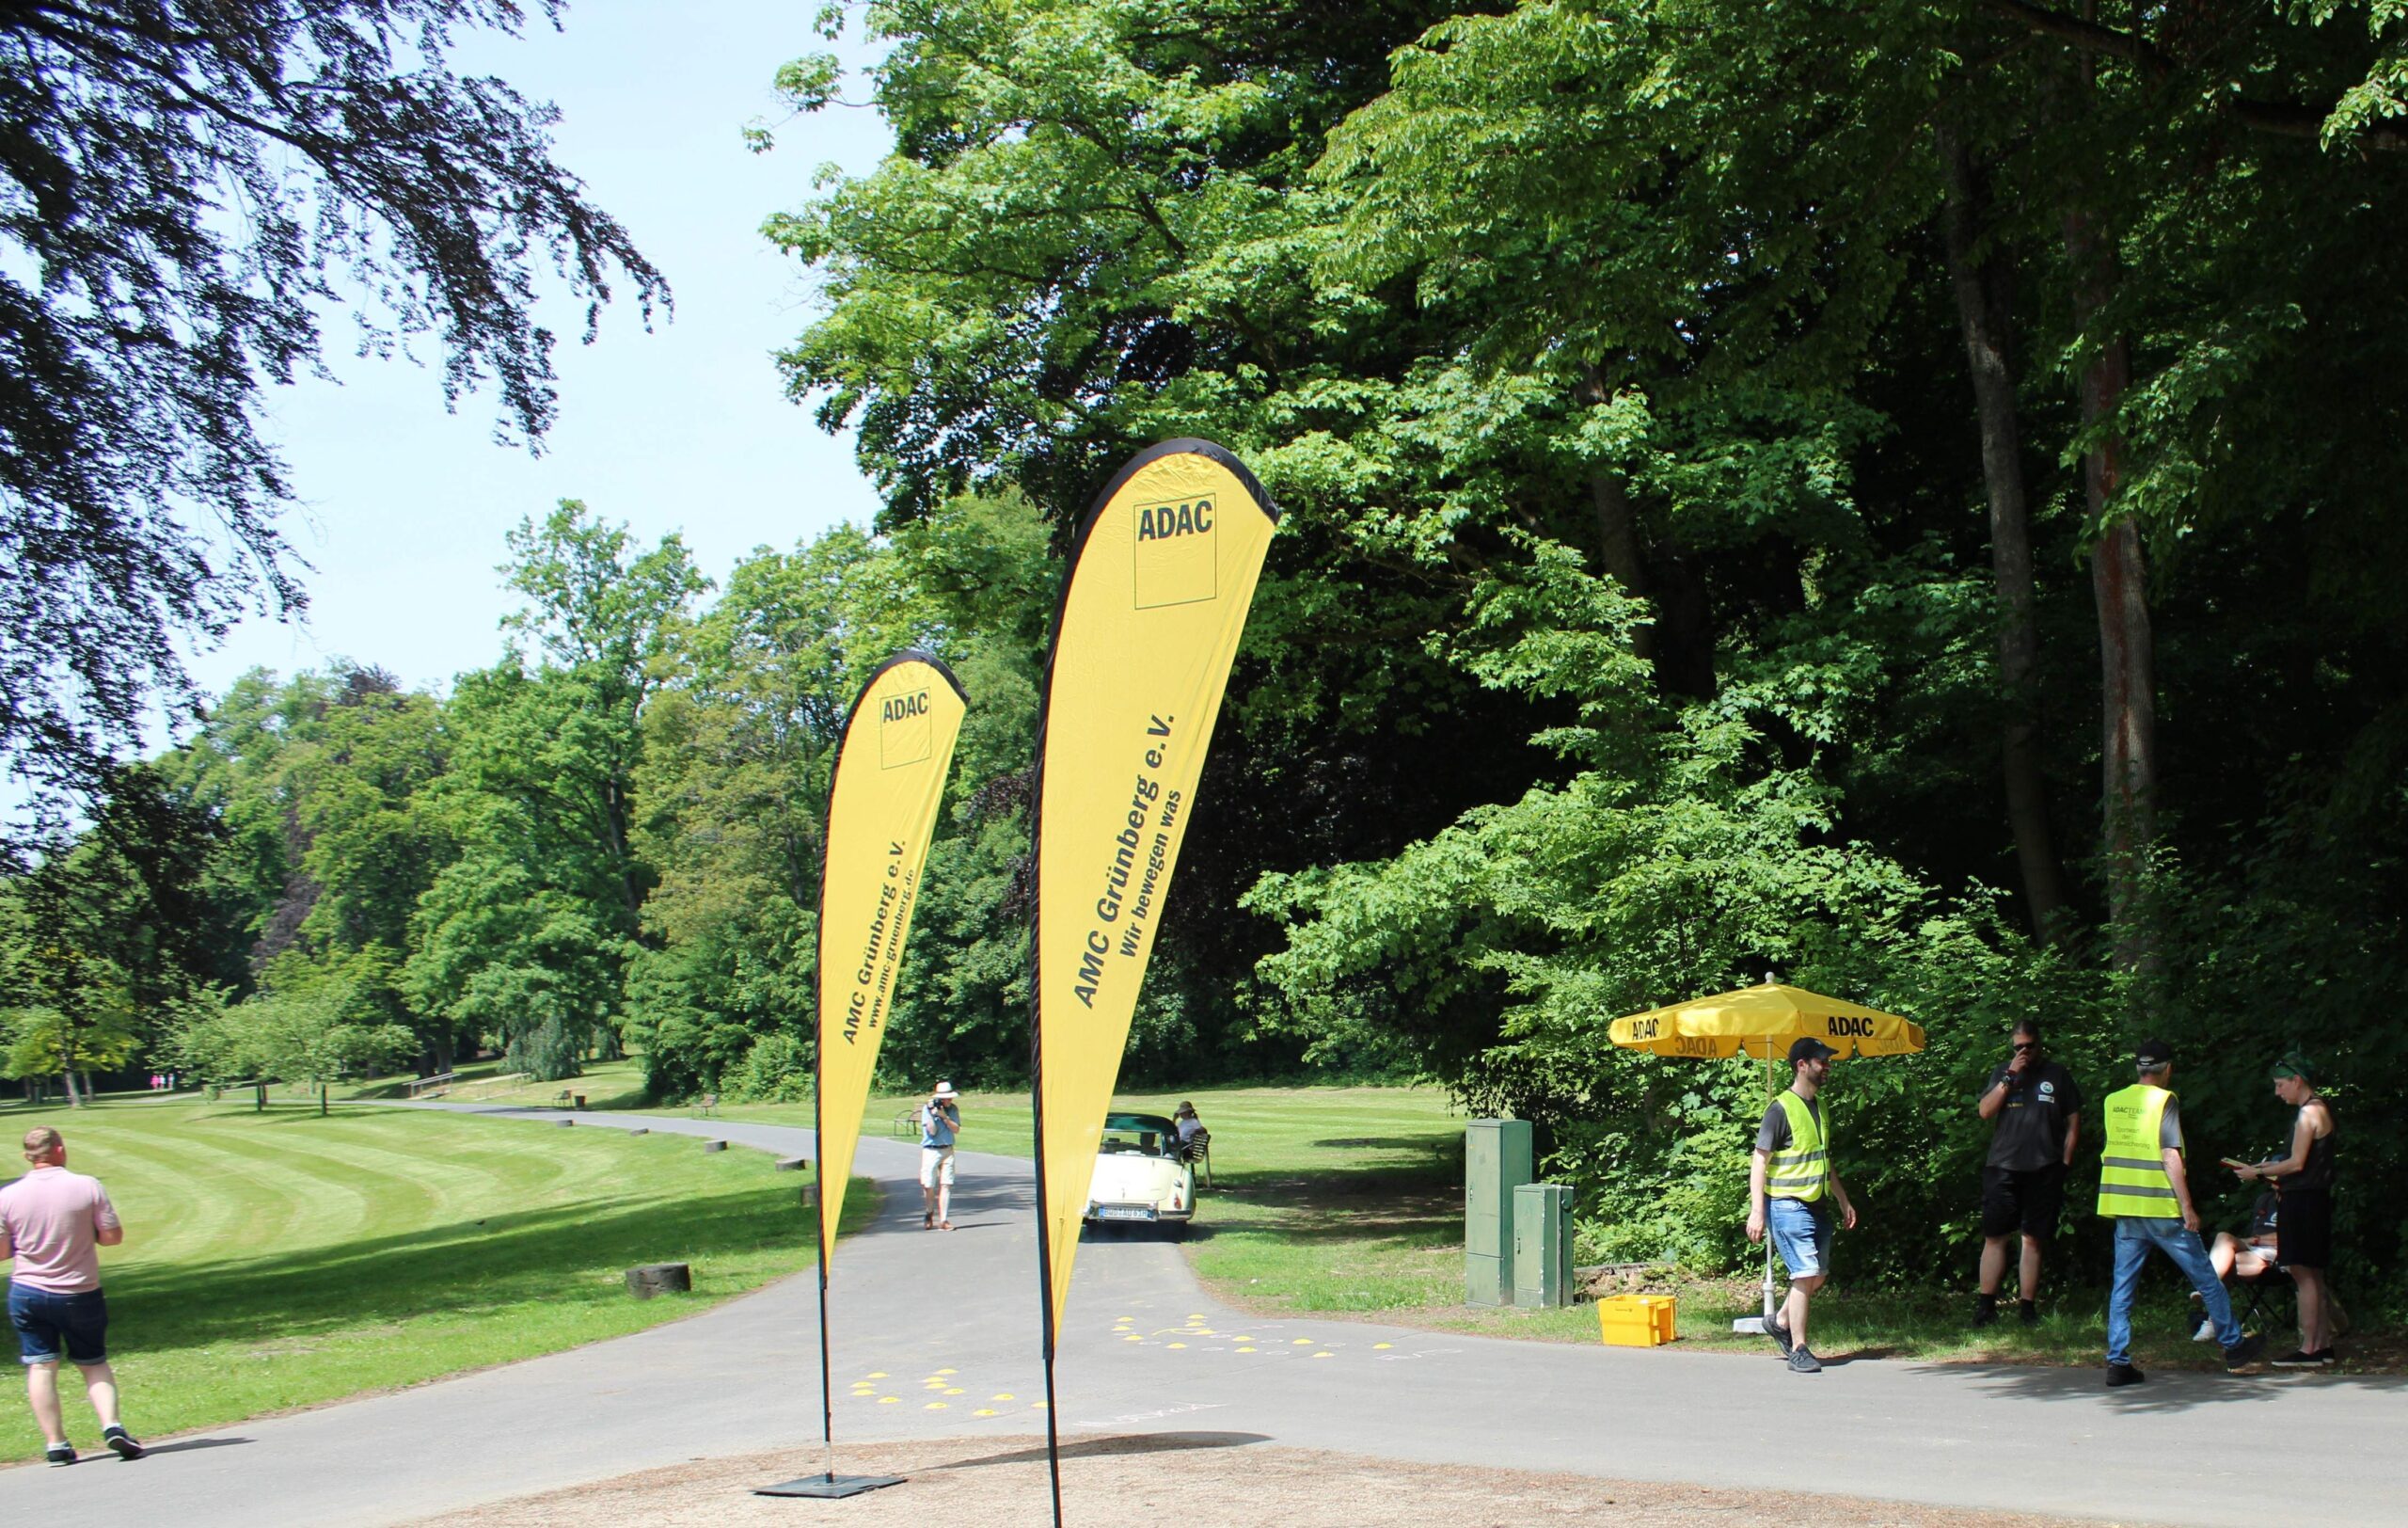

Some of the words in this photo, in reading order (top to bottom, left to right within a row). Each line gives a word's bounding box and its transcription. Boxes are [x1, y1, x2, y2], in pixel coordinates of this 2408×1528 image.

[1138, 500, 1213, 542] ADAC
[882, 692, 928, 724] ADAC
[1073, 930, 1110, 1010] AMC
[1097, 774, 1160, 923] Grünberg
[1145, 714, 1175, 769] e.V.
[1119, 922, 1143, 959] Wir
[1131, 833, 1168, 920] bewegen
[1160, 789, 1181, 829] was
[843, 991, 866, 1045] AMC
[857, 882, 897, 986] Grünberg
[888, 840, 906, 879] e.V.
[868, 868, 914, 1028] www.amc-gruenberg.de
[1632, 1018, 1659, 1041] ADAC
[1828, 1016, 1875, 1038] ADAC
